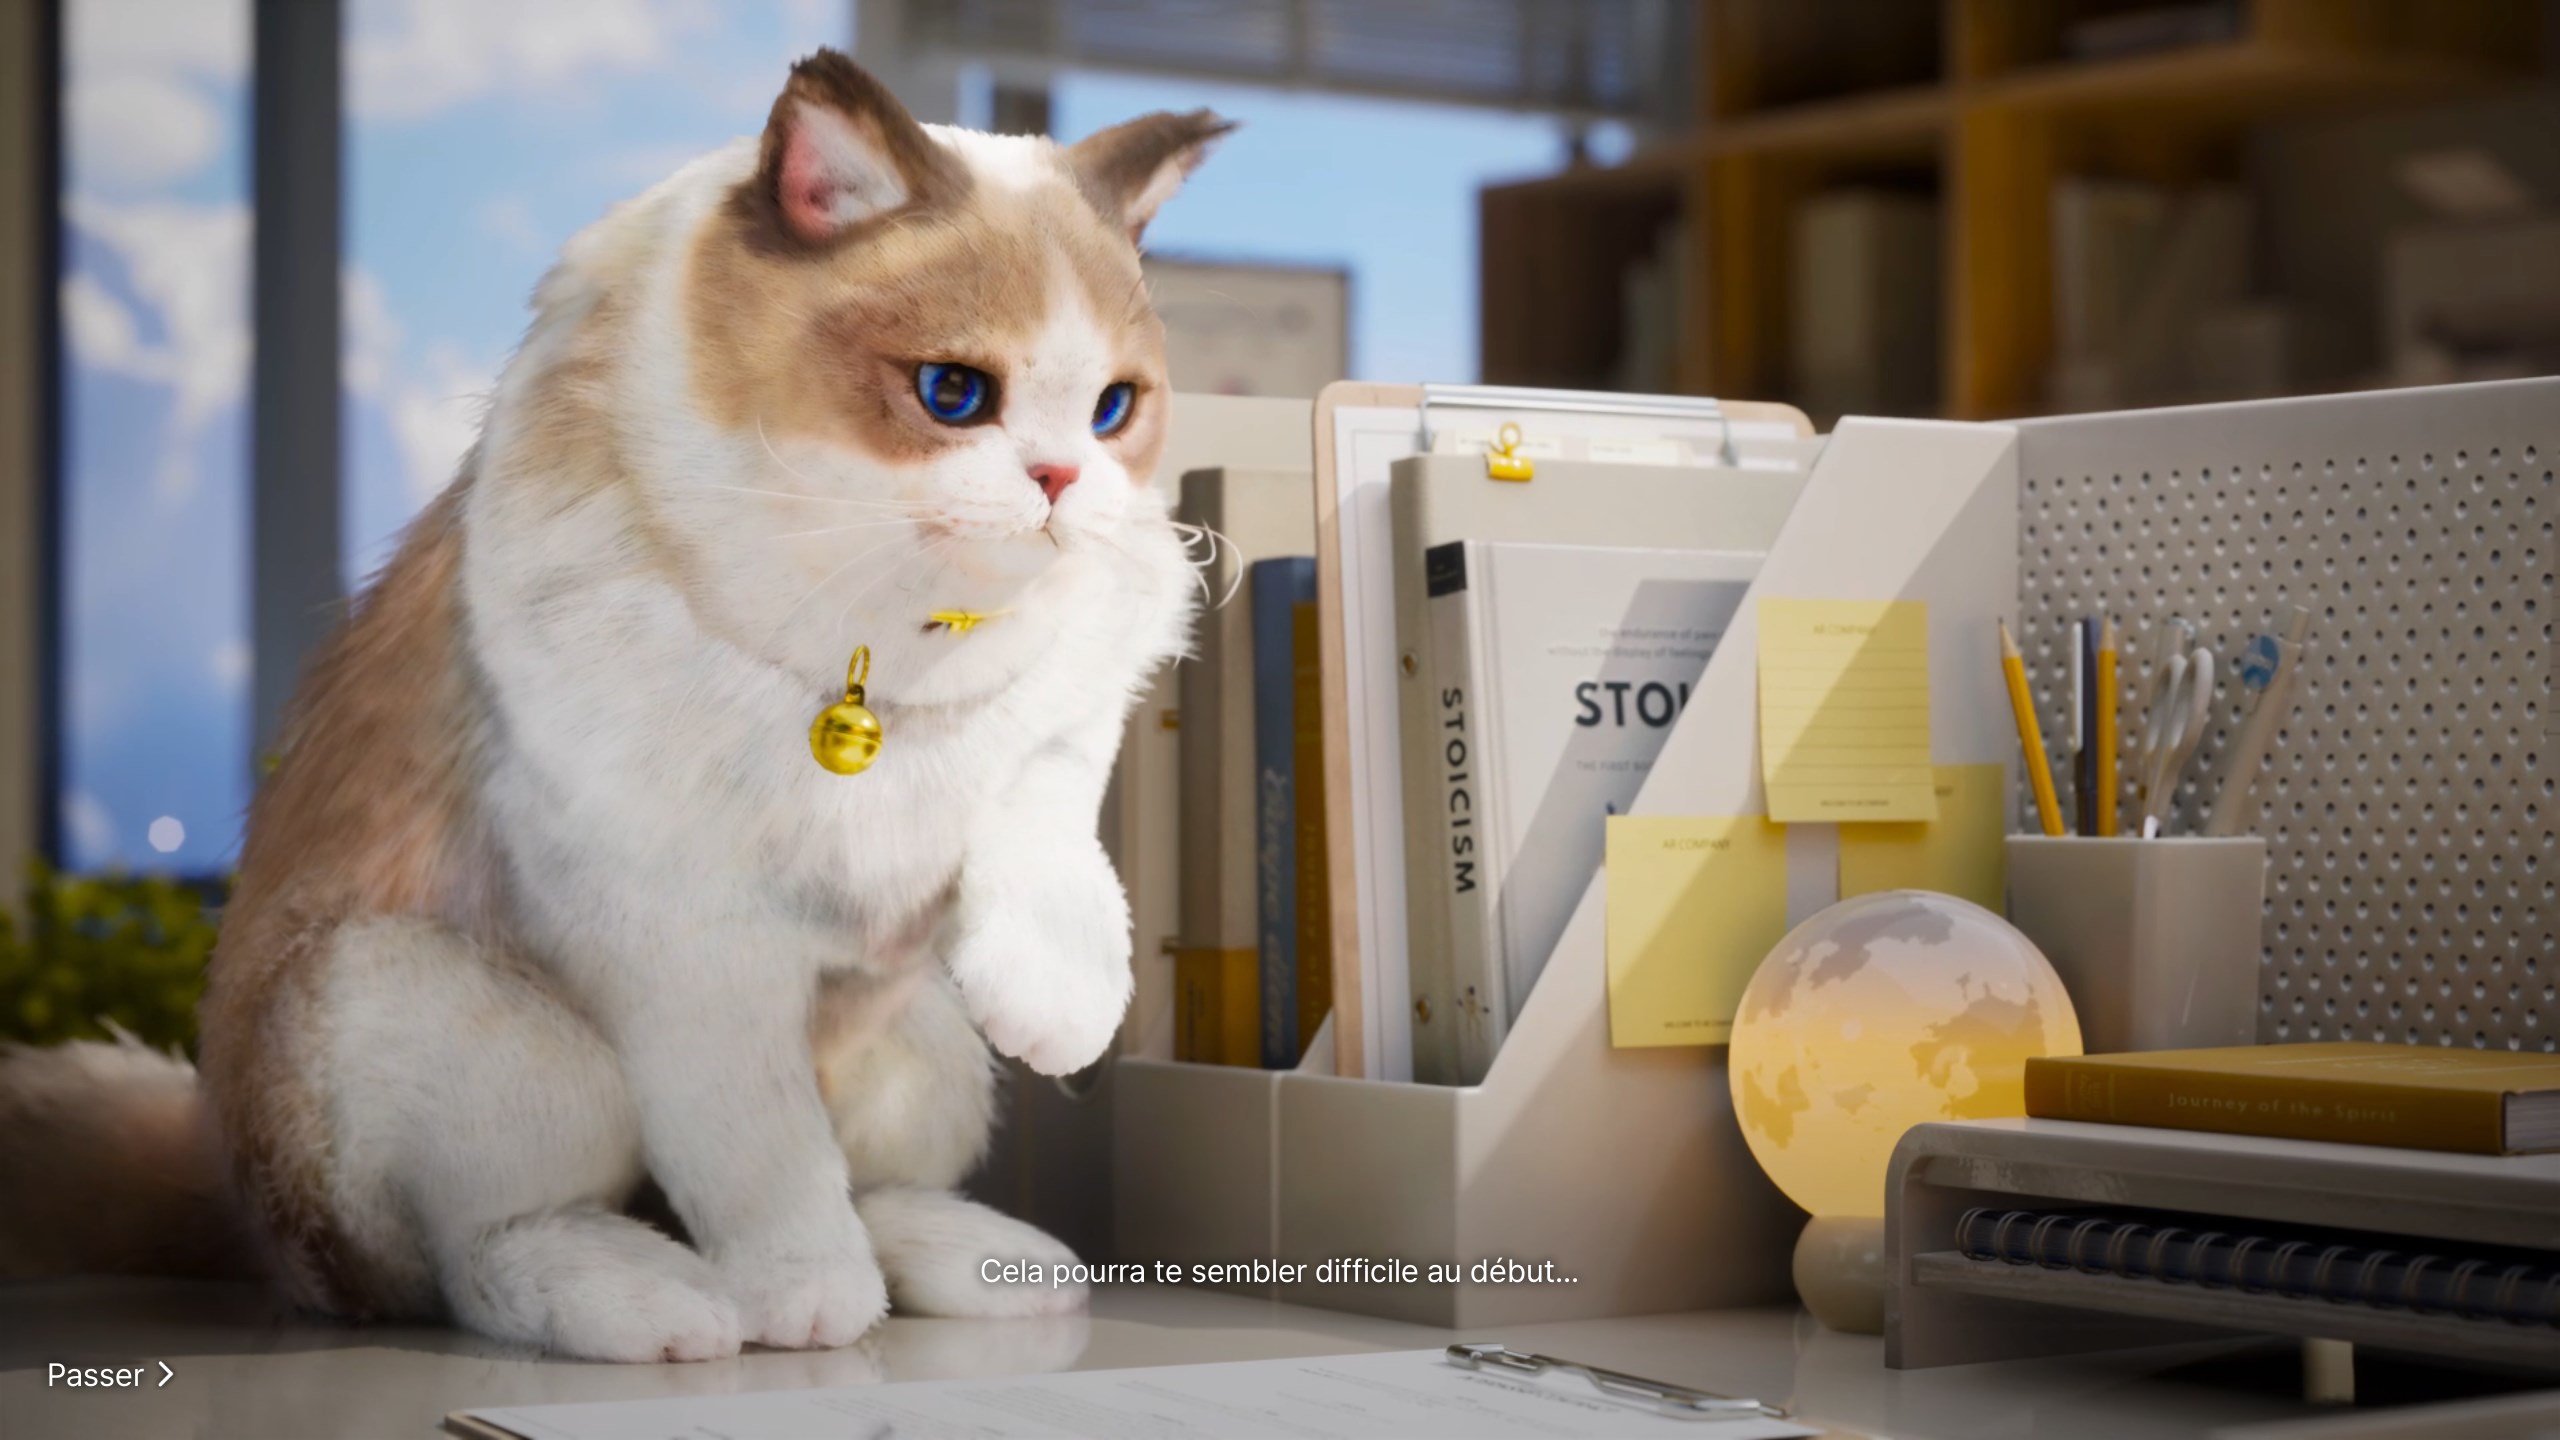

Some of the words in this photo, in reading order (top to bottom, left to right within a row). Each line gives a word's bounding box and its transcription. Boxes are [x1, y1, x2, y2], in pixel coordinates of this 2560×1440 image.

[1680, 627, 1691, 639] of
[1654, 646, 1667, 657] of
[1576, 761, 1596, 772] THE
[1600, 760, 1630, 772] FIRST
[1442, 687, 1476, 894] STOICISM
[1662, 838, 1677, 849] AR
[1679, 837, 1731, 850] COMPANY
[2168, 1092, 2248, 1114] Journey
[2257, 1098, 2281, 1114] of
[2289, 1101, 2324, 1119] the
[2334, 1104, 2398, 1124] Spirit
